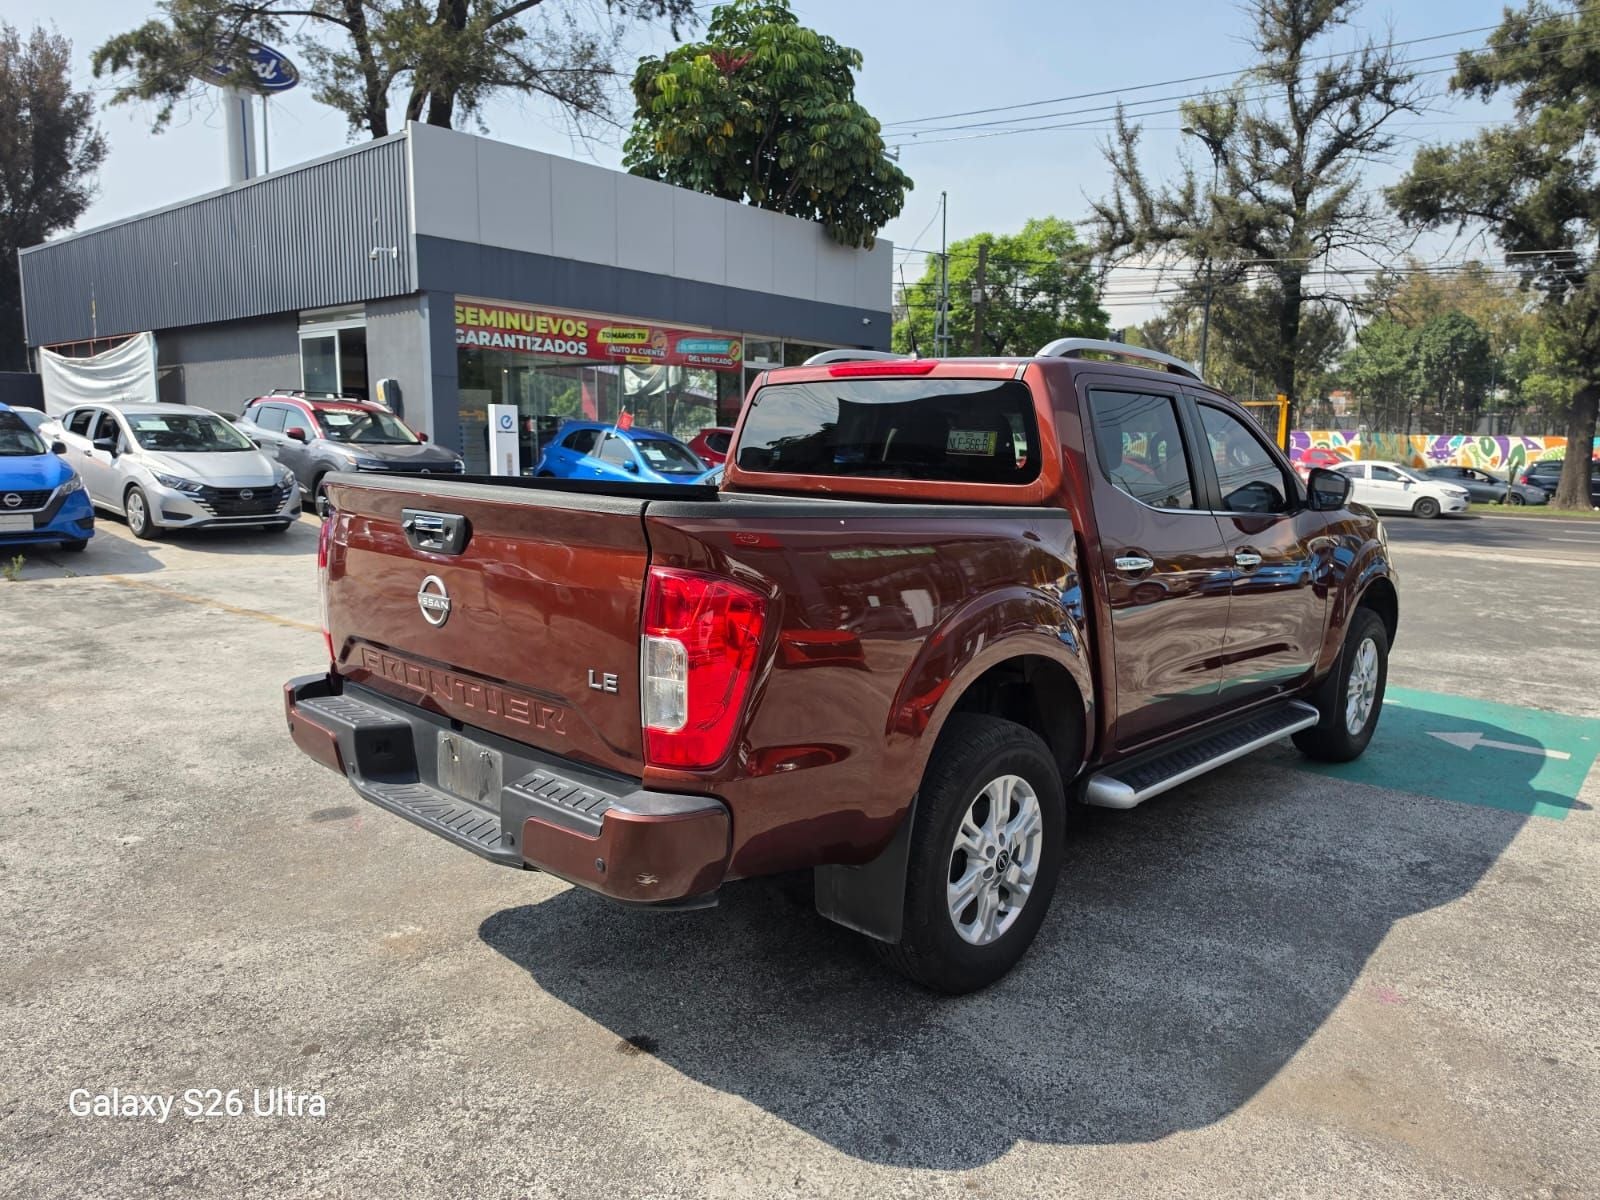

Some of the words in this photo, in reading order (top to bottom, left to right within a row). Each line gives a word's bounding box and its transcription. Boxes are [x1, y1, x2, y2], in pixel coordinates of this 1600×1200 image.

[455, 305, 588, 338] SEMINUEVOS
[455, 329, 588, 355] GARANTIZADOS
[639, 348, 665, 357] CUENTA
[702, 357, 733, 365] MERCADO
[361, 647, 566, 735] FRONTIER
[588, 669, 618, 692] LE
